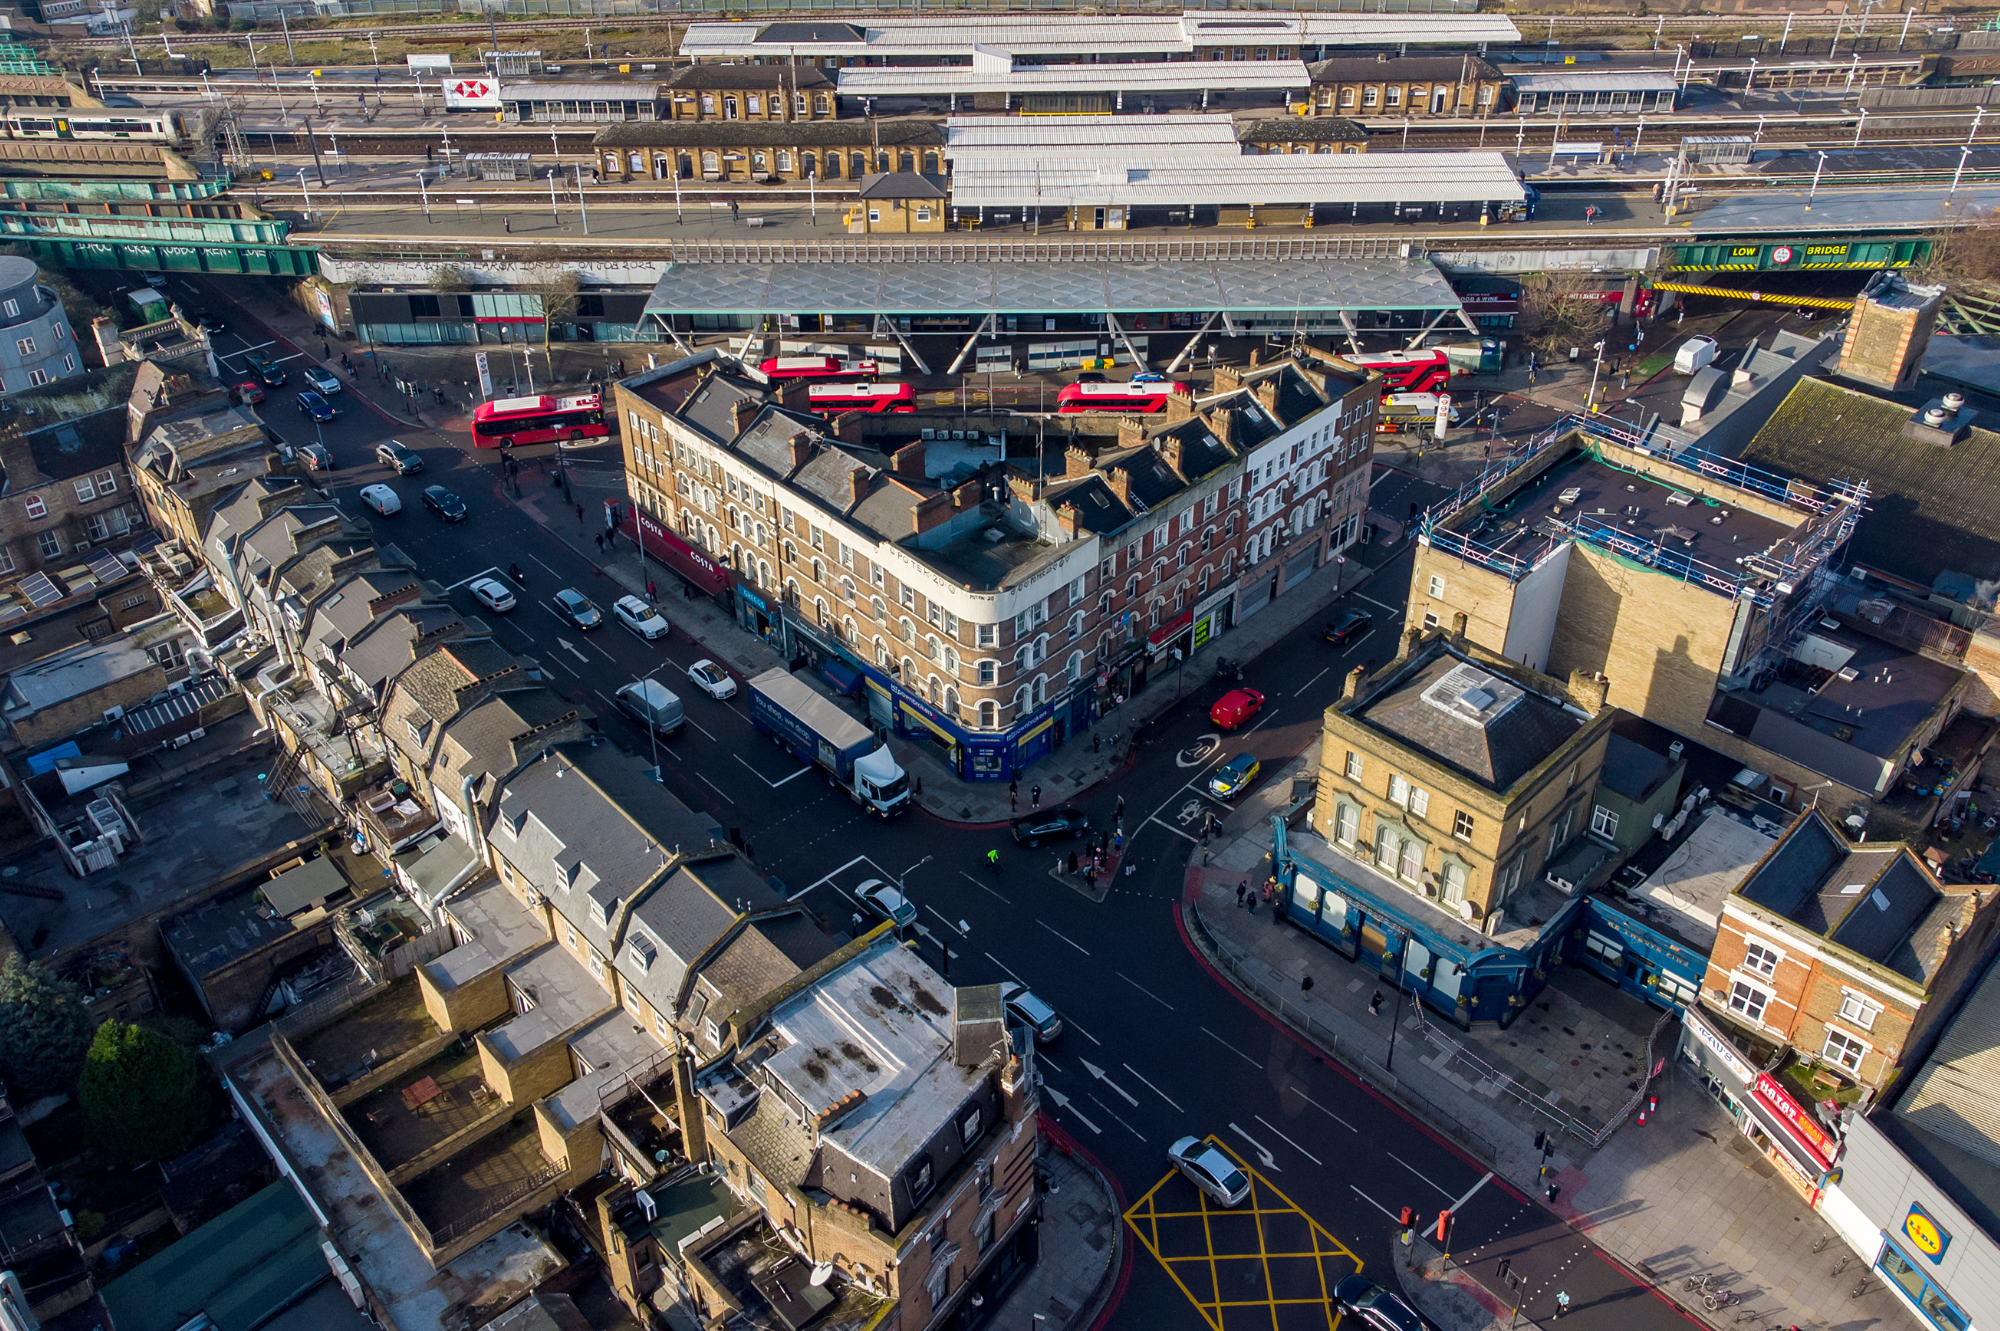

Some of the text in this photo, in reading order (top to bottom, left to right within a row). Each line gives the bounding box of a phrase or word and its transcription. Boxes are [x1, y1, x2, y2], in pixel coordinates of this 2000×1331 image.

[1732, 247, 1756, 256] LOW
[1806, 245, 1848, 255] BRIDGE
[640, 517, 664, 538] COSTA
[690, 551, 715, 573] COSTA
[754, 694, 767, 708] You
[1759, 1079, 1797, 1119] HAYAT
